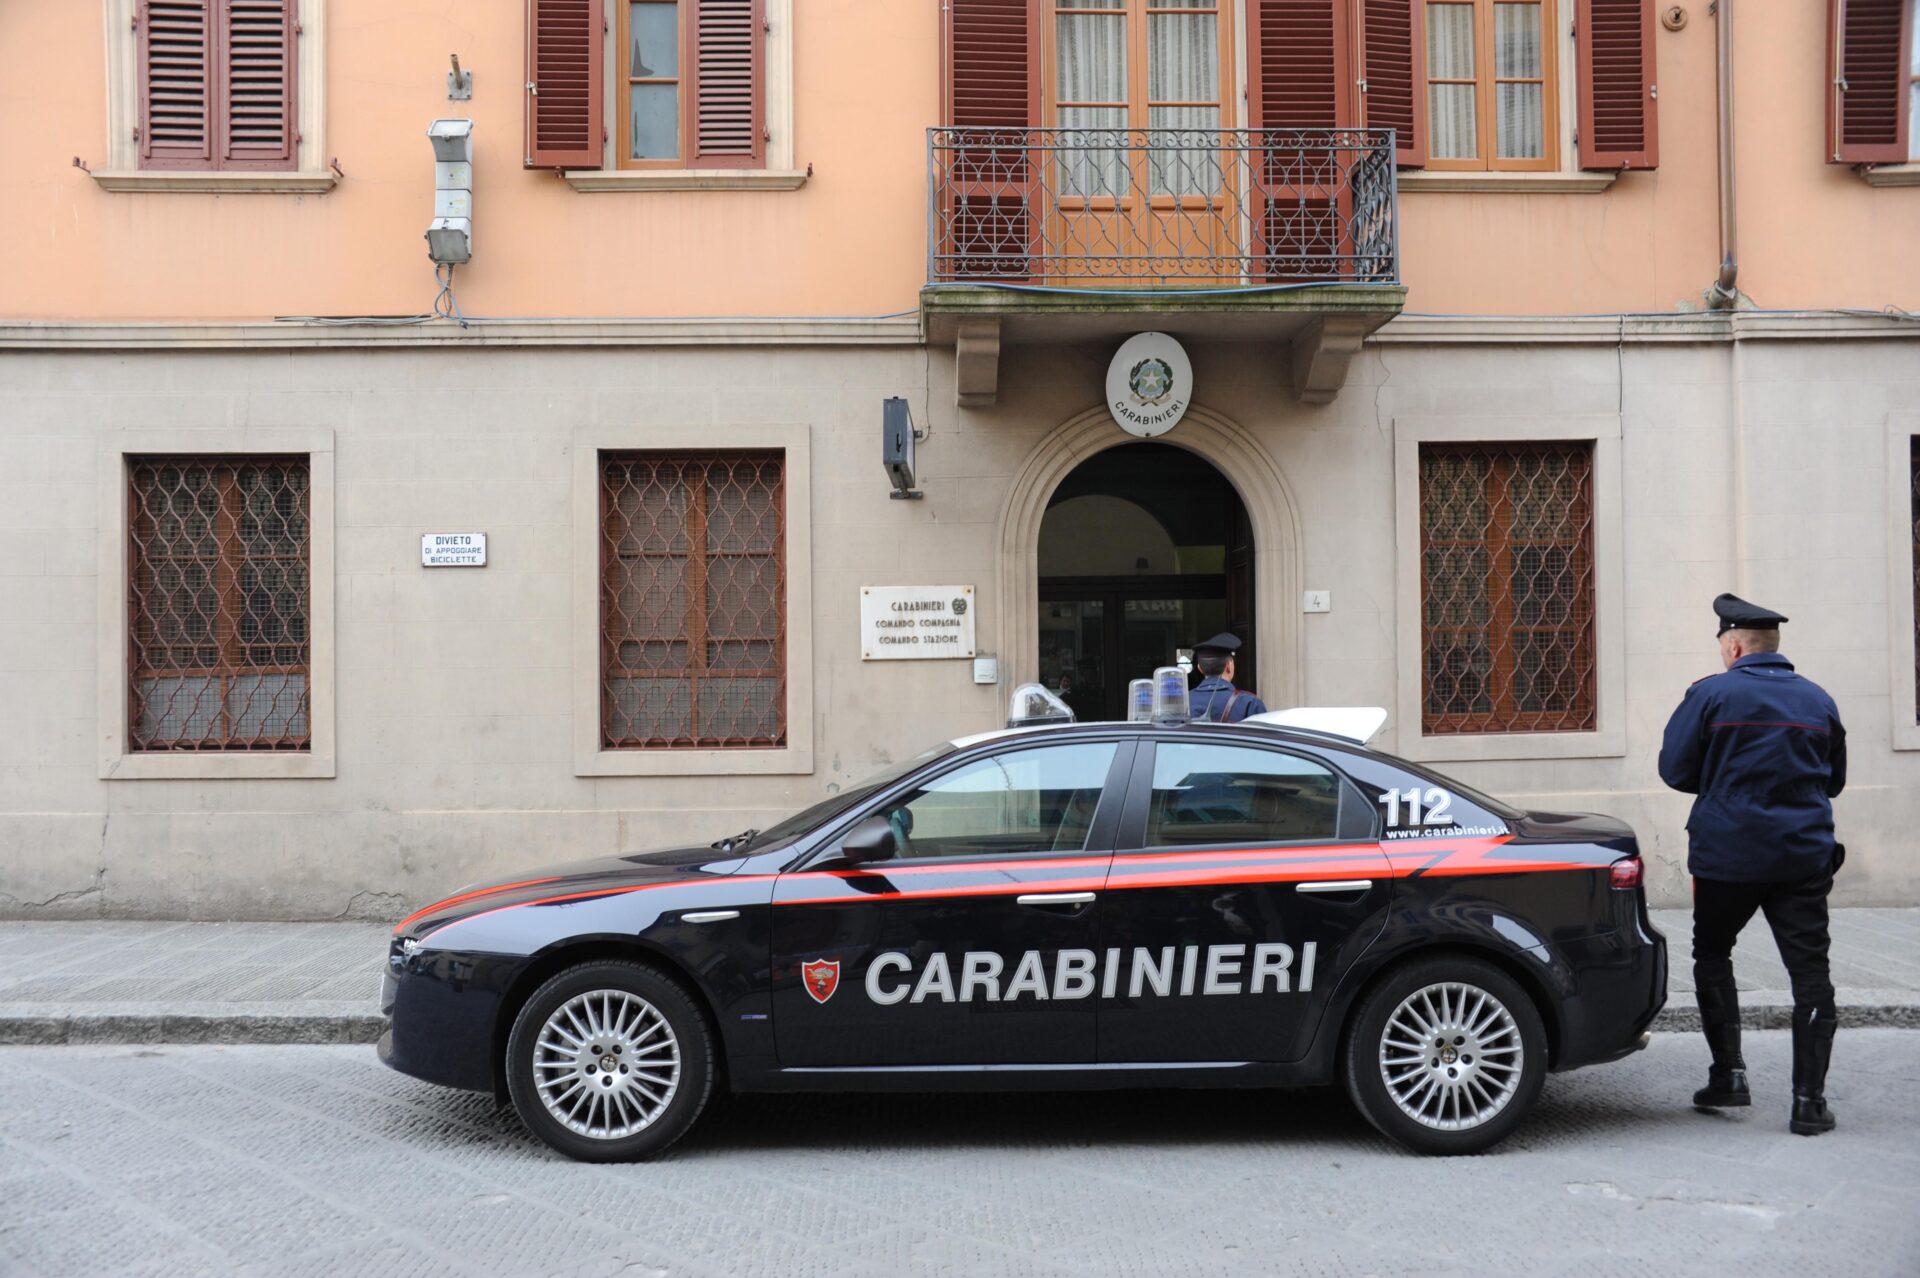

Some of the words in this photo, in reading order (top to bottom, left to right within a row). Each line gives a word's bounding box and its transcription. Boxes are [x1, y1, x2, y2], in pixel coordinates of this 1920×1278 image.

[1115, 400, 1184, 425] CARABINIERI
[435, 536, 471, 545] DIVIETO
[891, 601, 945, 612] CARABINIERI
[1312, 594, 1321, 608] 4
[875, 619, 915, 628] COMANDO
[919, 618, 961, 627] COMPAGNIA
[879, 635, 919, 645] COMANDO
[923, 635, 959, 643] STAZIONE
[1378, 787, 1453, 827] 112
[1386, 826, 1510, 839] www.carabinieri.it
[864, 941, 1317, 1005] CARABINIERI
